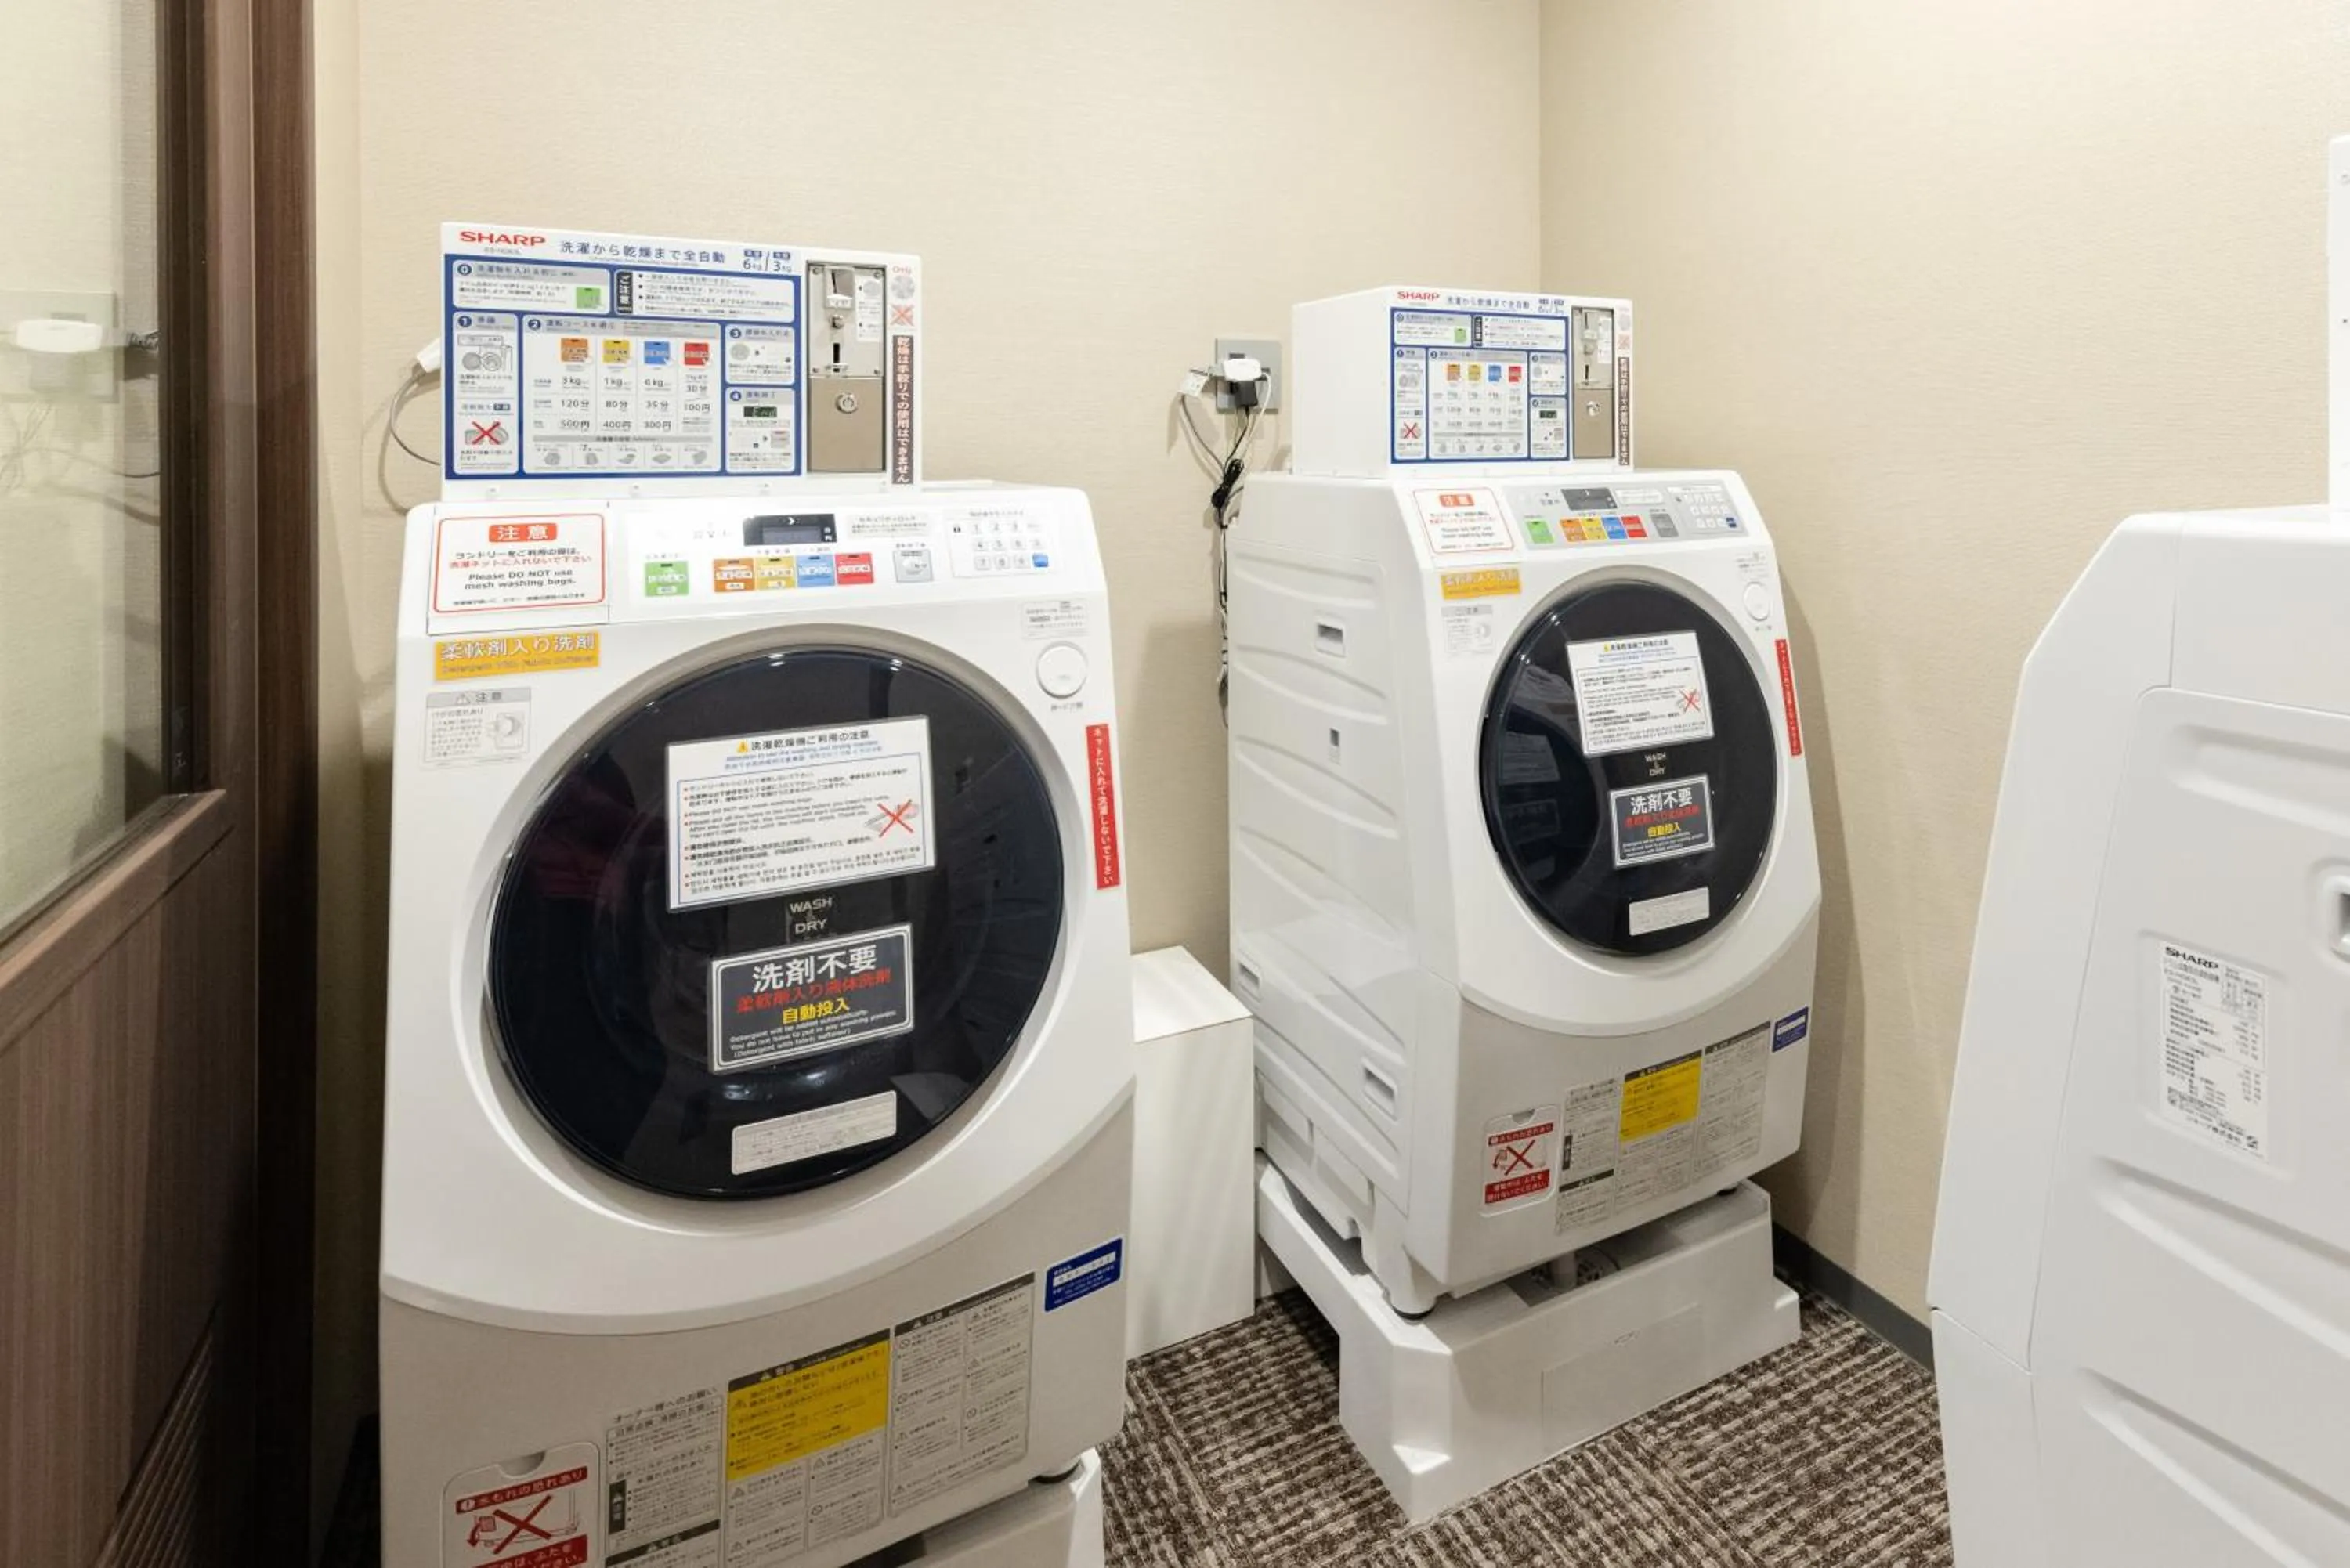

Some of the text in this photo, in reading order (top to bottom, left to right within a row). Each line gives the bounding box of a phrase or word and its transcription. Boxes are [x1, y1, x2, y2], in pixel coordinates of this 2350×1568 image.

[460, 231, 546, 246] SHARP
[561, 240, 725, 264] 洗濯から乾燥まで全自動
[1397, 291, 1440, 301] SHARP
[497, 526, 548, 540] 注意
[468, 573, 505, 581] Please
[508, 571, 524, 580] DO
[528, 569, 551, 579] NOT
[465, 581, 494, 590] mesh
[498, 579, 544, 589] washing
[441, 633, 595, 662] 柔軟剤入り洗剤
[1630, 787, 1692, 815] 洗剤不要
[790, 898, 833, 914] WASH
[795, 919, 827, 935] DRY
[2165, 946, 2219, 969] SHARP
[752, 944, 877, 994] 洗剤不要
[783, 997, 851, 1025] 自動投入
